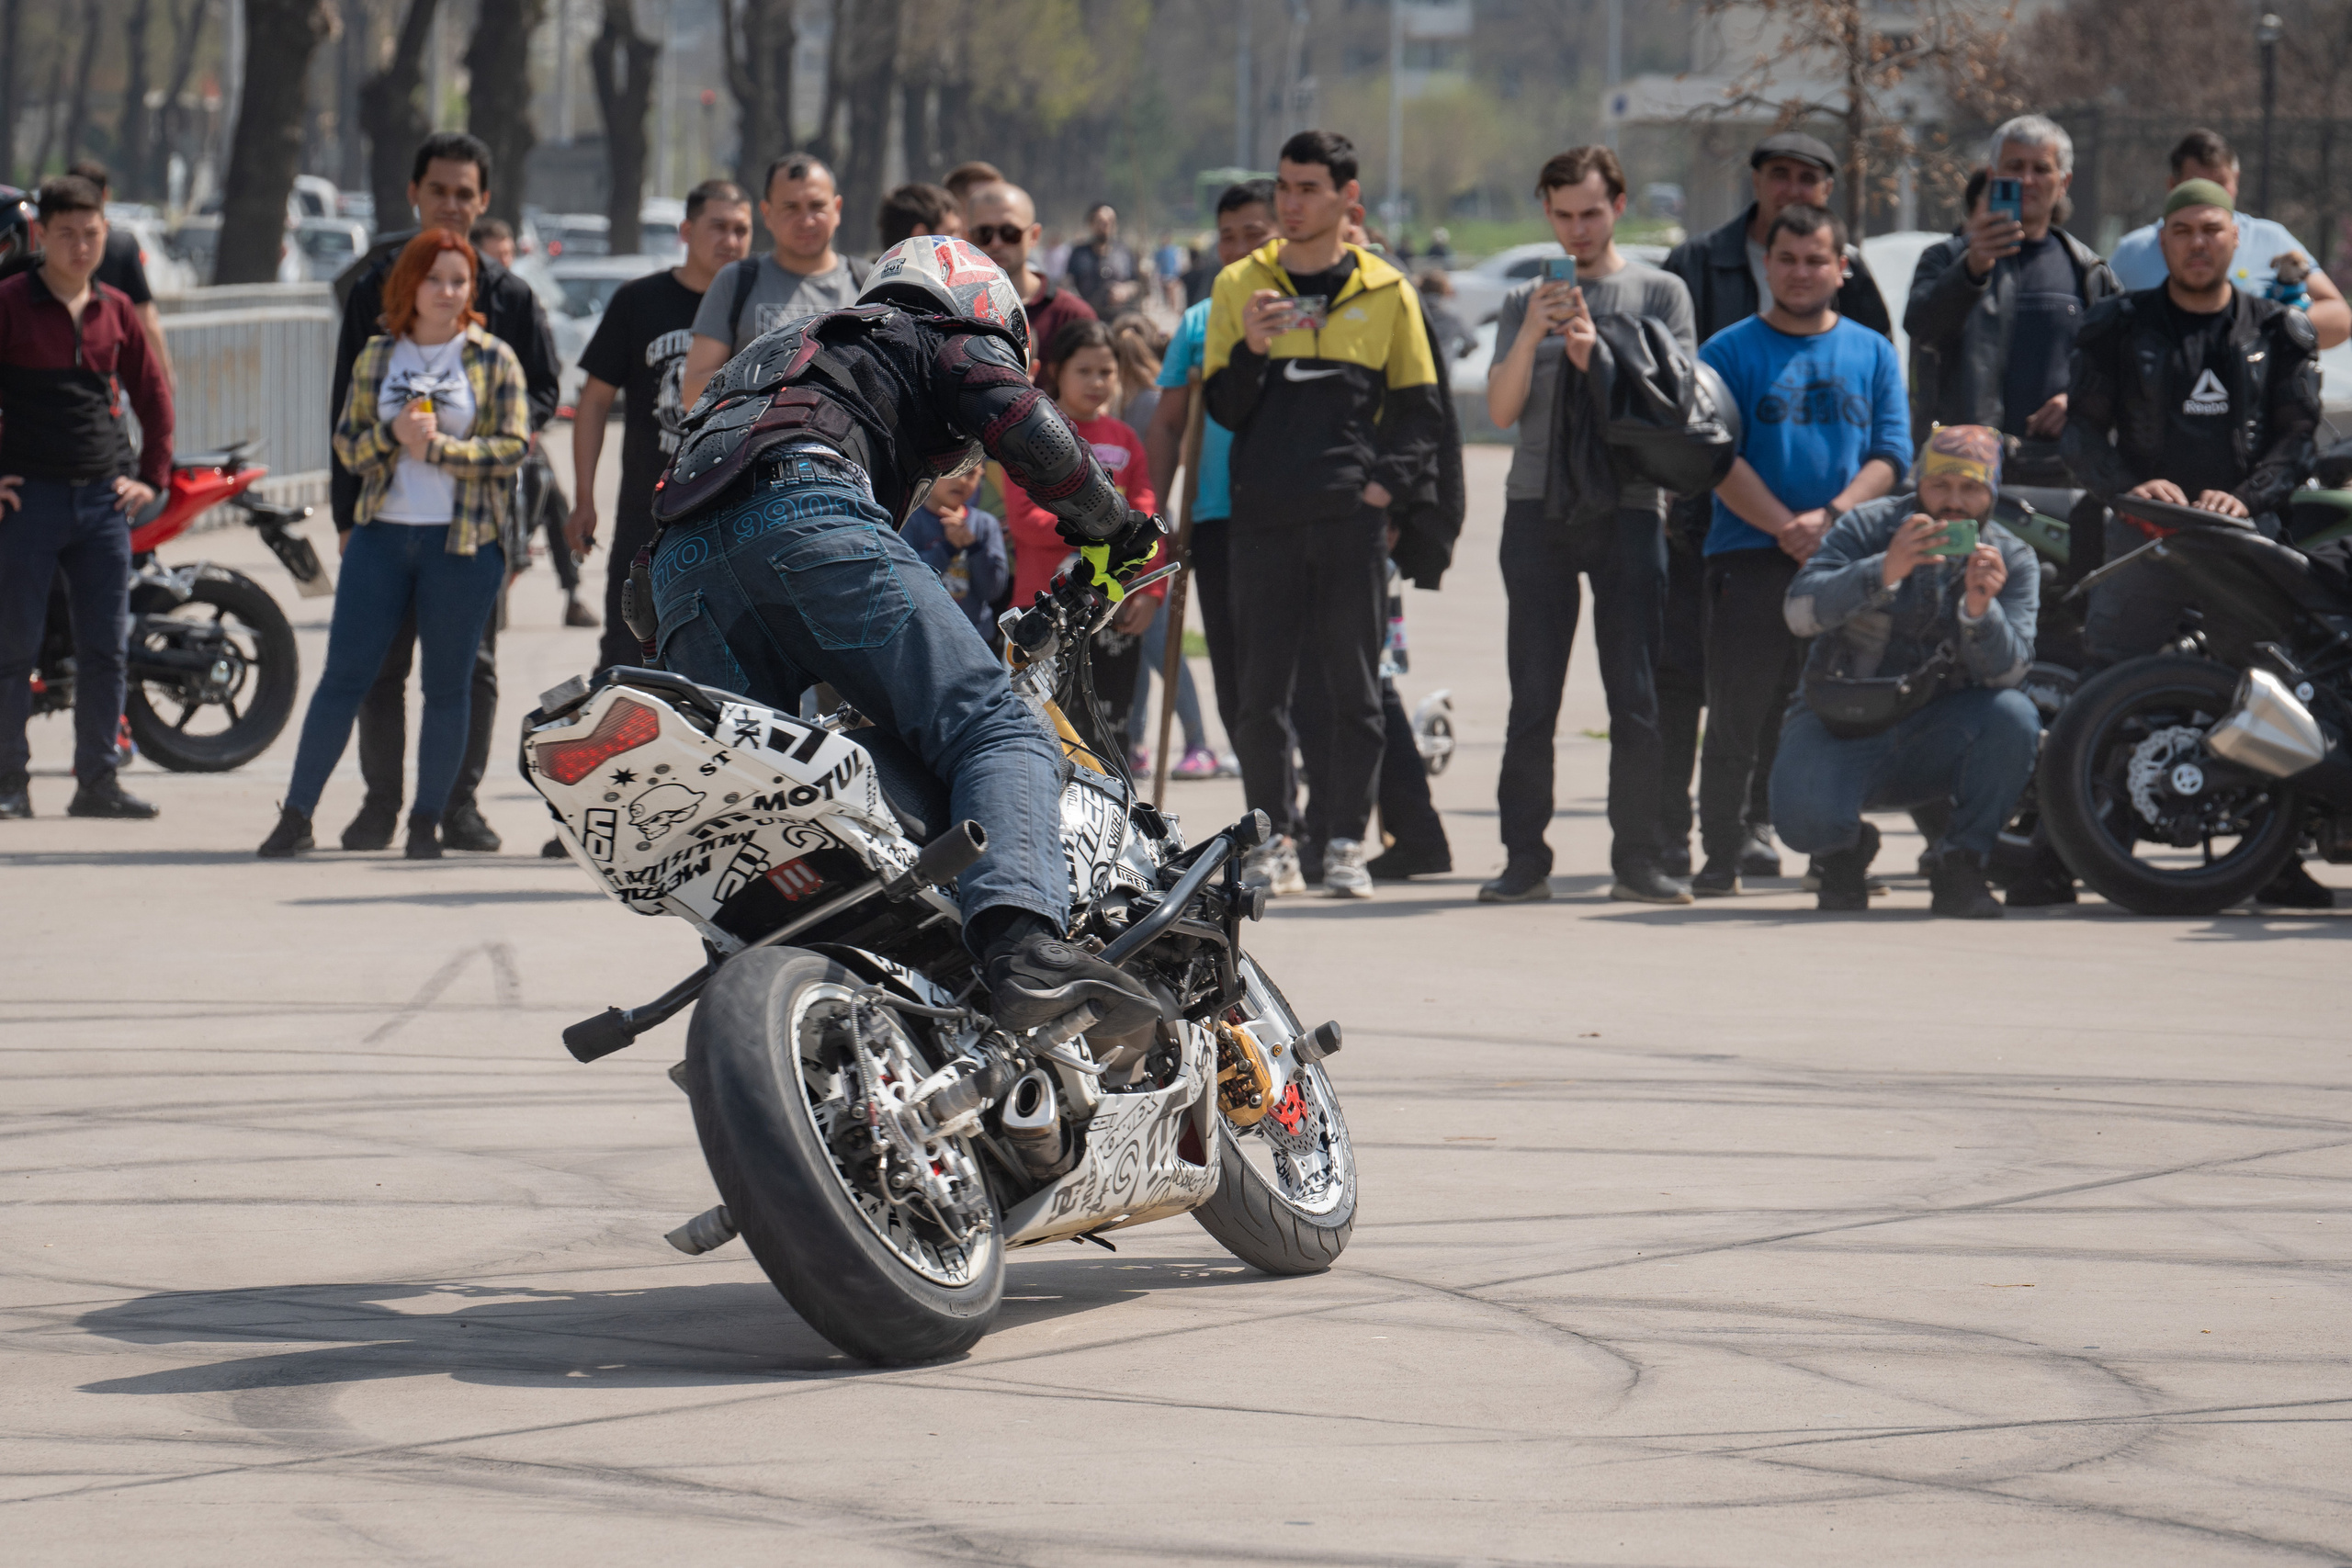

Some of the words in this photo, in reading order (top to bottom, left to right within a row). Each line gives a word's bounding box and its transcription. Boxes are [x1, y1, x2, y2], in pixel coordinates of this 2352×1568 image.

[2183, 400, 2229, 414] Reebo
[752, 748, 865, 811] MOTUL
[1107, 807, 1123, 850] SHOEI
